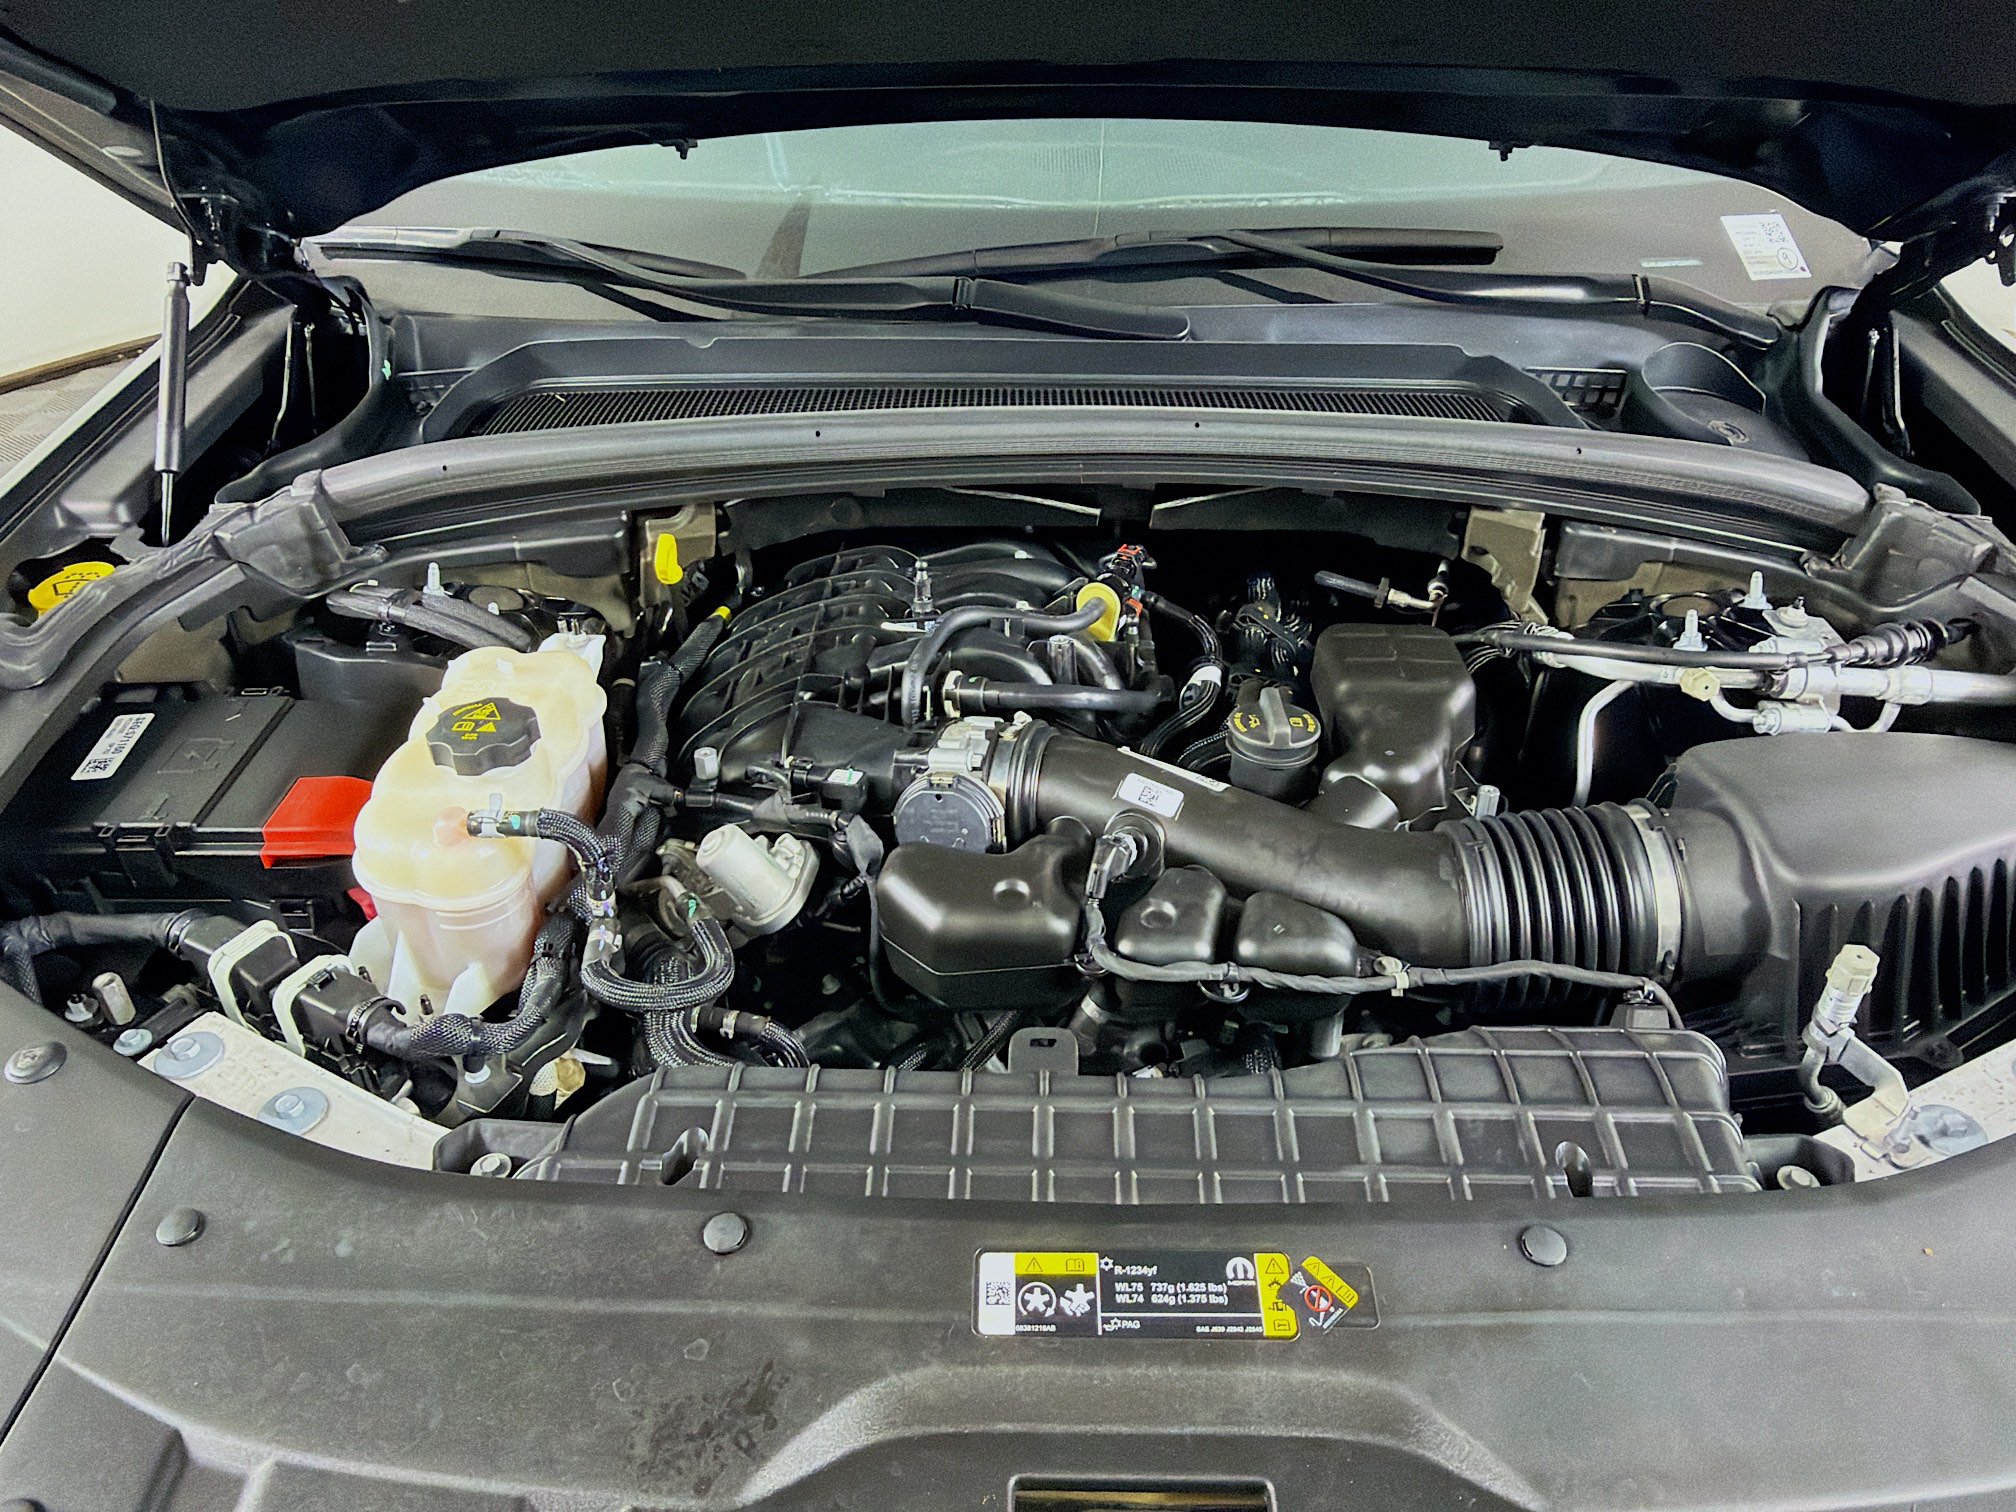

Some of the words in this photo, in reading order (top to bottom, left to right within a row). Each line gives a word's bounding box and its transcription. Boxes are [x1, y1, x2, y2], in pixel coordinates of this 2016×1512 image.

[1113, 1265, 1158, 1277] R-1234yf
[1114, 1282, 1144, 1292] WL75
[1150, 1282, 1175, 1294] 737g
[1176, 1282, 1207, 1294] (1.625
[1207, 1282, 1228, 1294] lbs)
[1115, 1293, 1145, 1304] WL74
[1150, 1293, 1176, 1306] 624g
[1177, 1293, 1208, 1305] (1.375
[1208, 1293, 1229, 1306] lbs)
[1121, 1320, 1141, 1329] PAG
